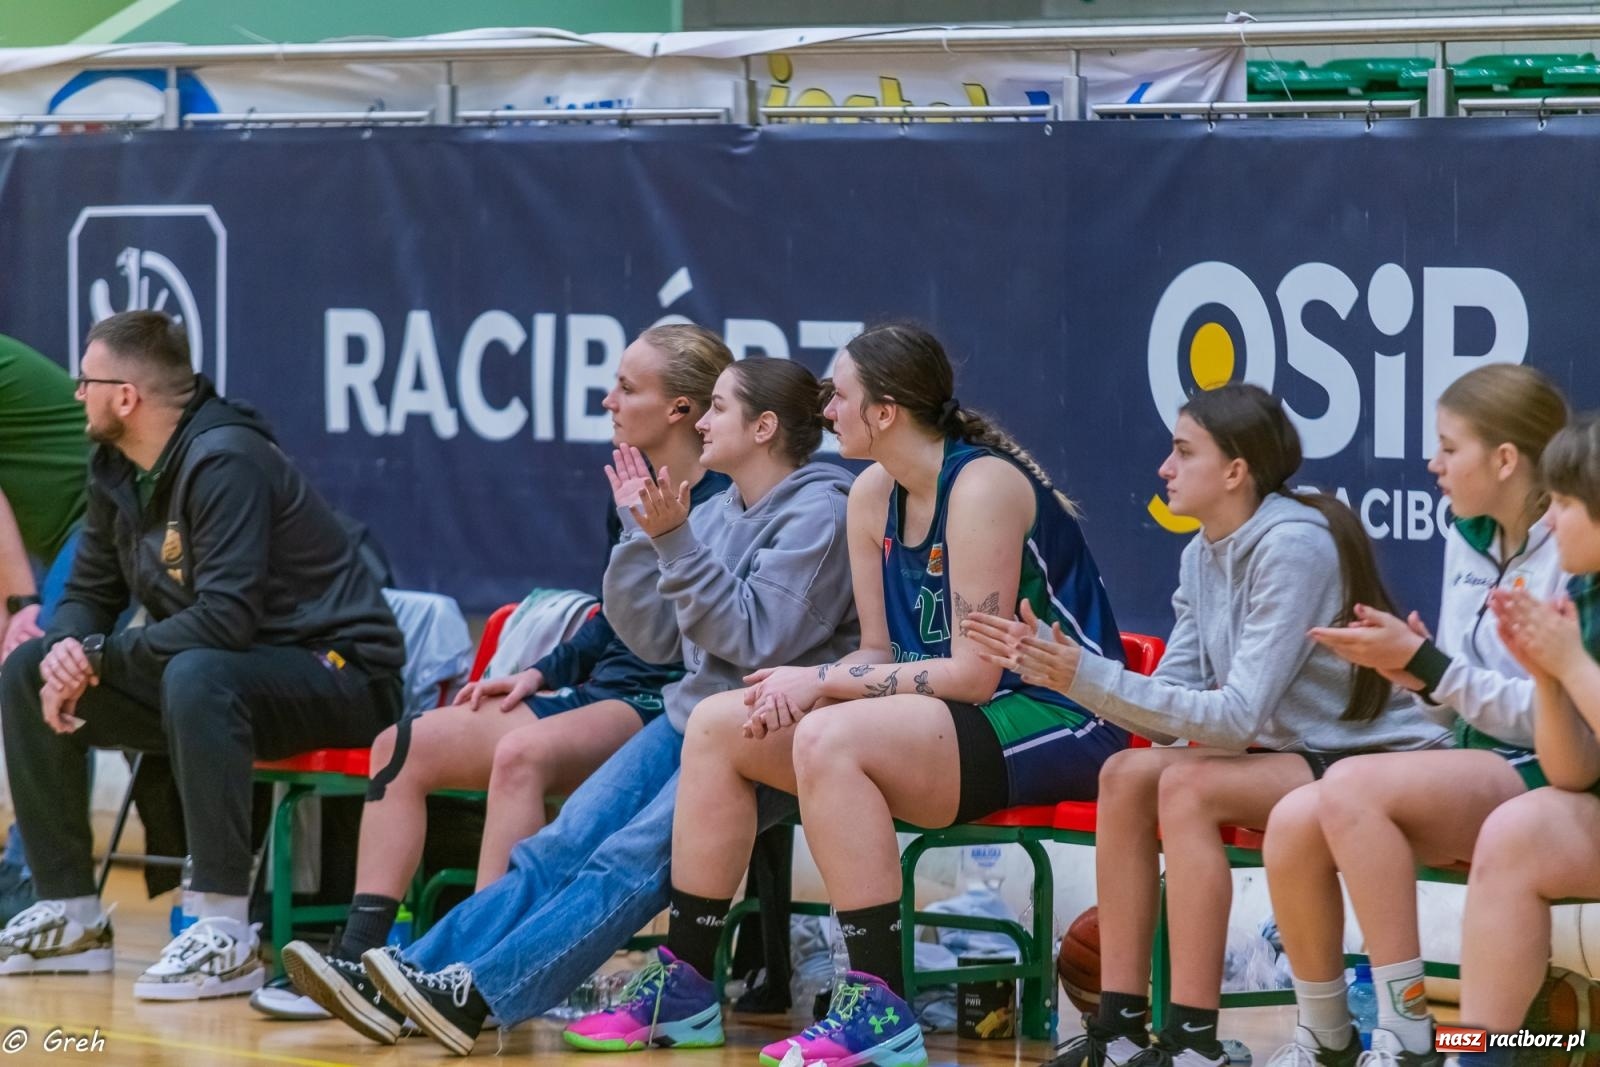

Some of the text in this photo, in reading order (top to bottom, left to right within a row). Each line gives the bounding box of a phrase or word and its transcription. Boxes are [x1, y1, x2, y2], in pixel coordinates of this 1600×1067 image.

[324, 266, 867, 452] RACIB
[1296, 485, 1452, 541] CIB
[914, 585, 951, 644] 21
